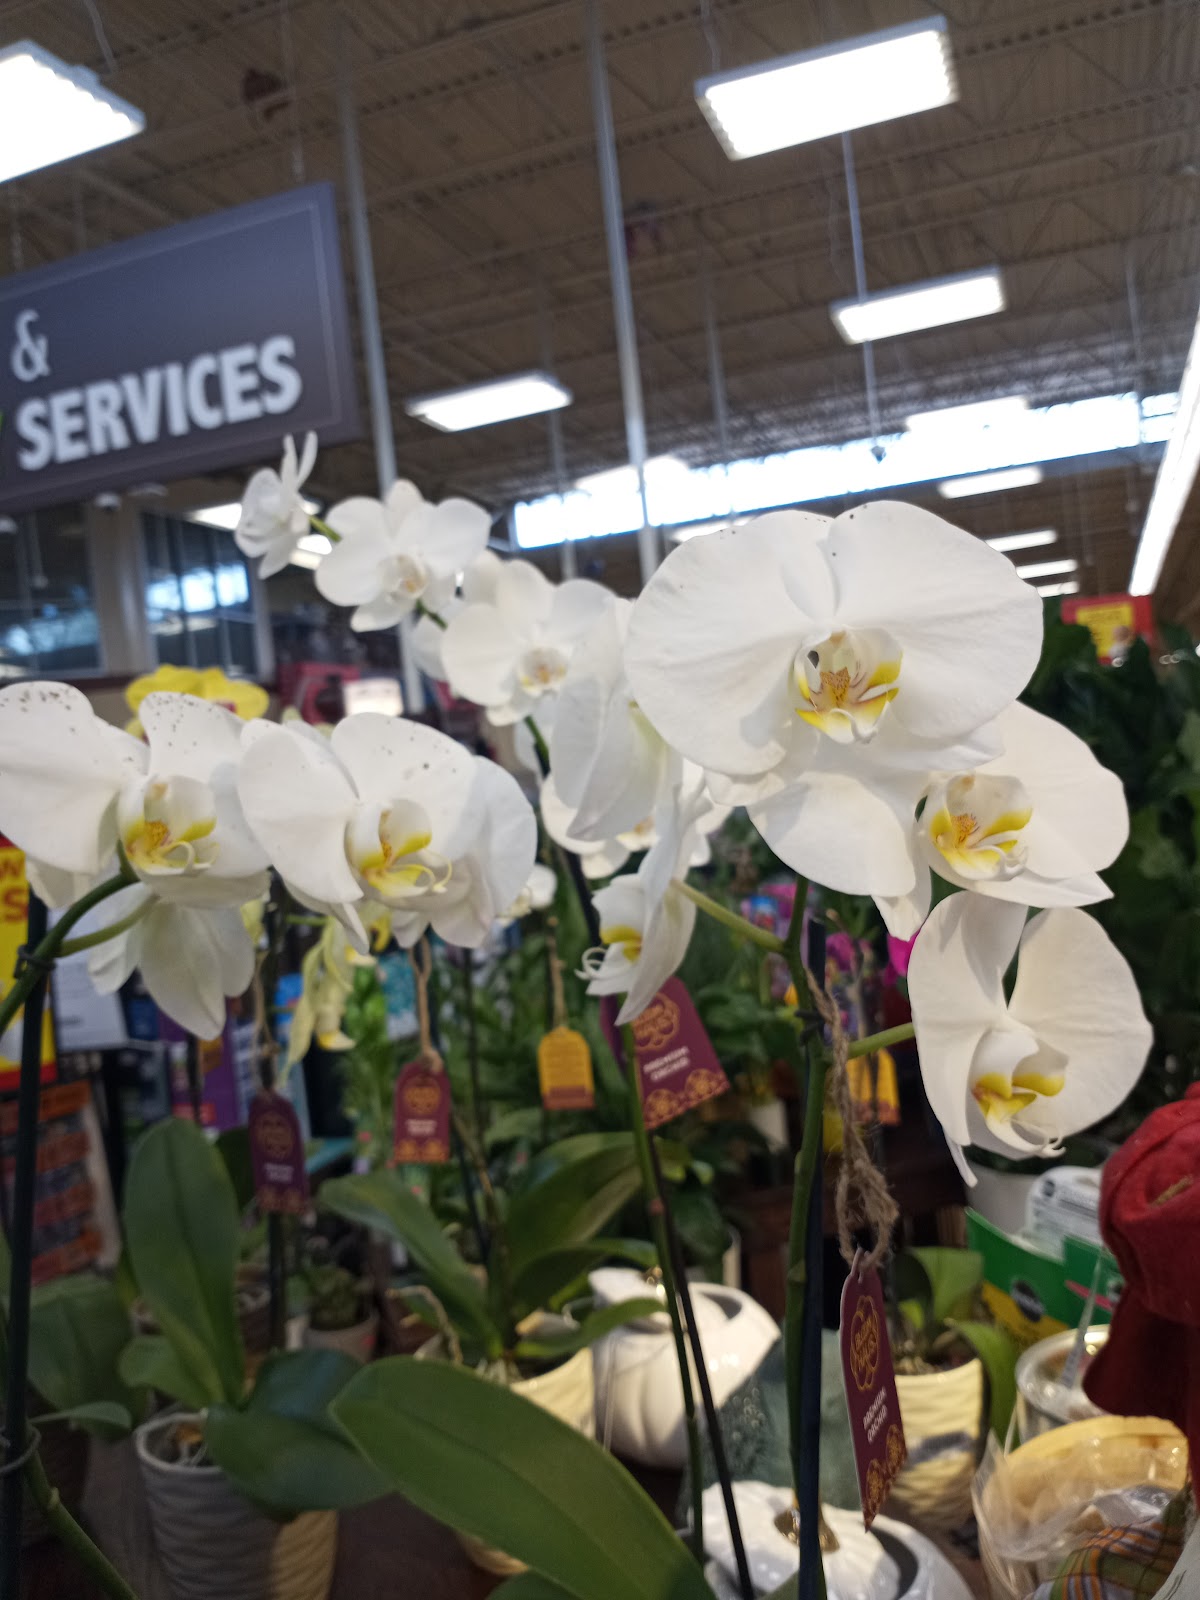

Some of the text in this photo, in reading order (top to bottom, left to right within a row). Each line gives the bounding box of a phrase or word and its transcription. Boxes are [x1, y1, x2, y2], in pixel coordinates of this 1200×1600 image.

[12, 309, 50, 381] &
[17, 335, 302, 471] SERVICES
[867, 1404, 888, 1443] ORCHID
